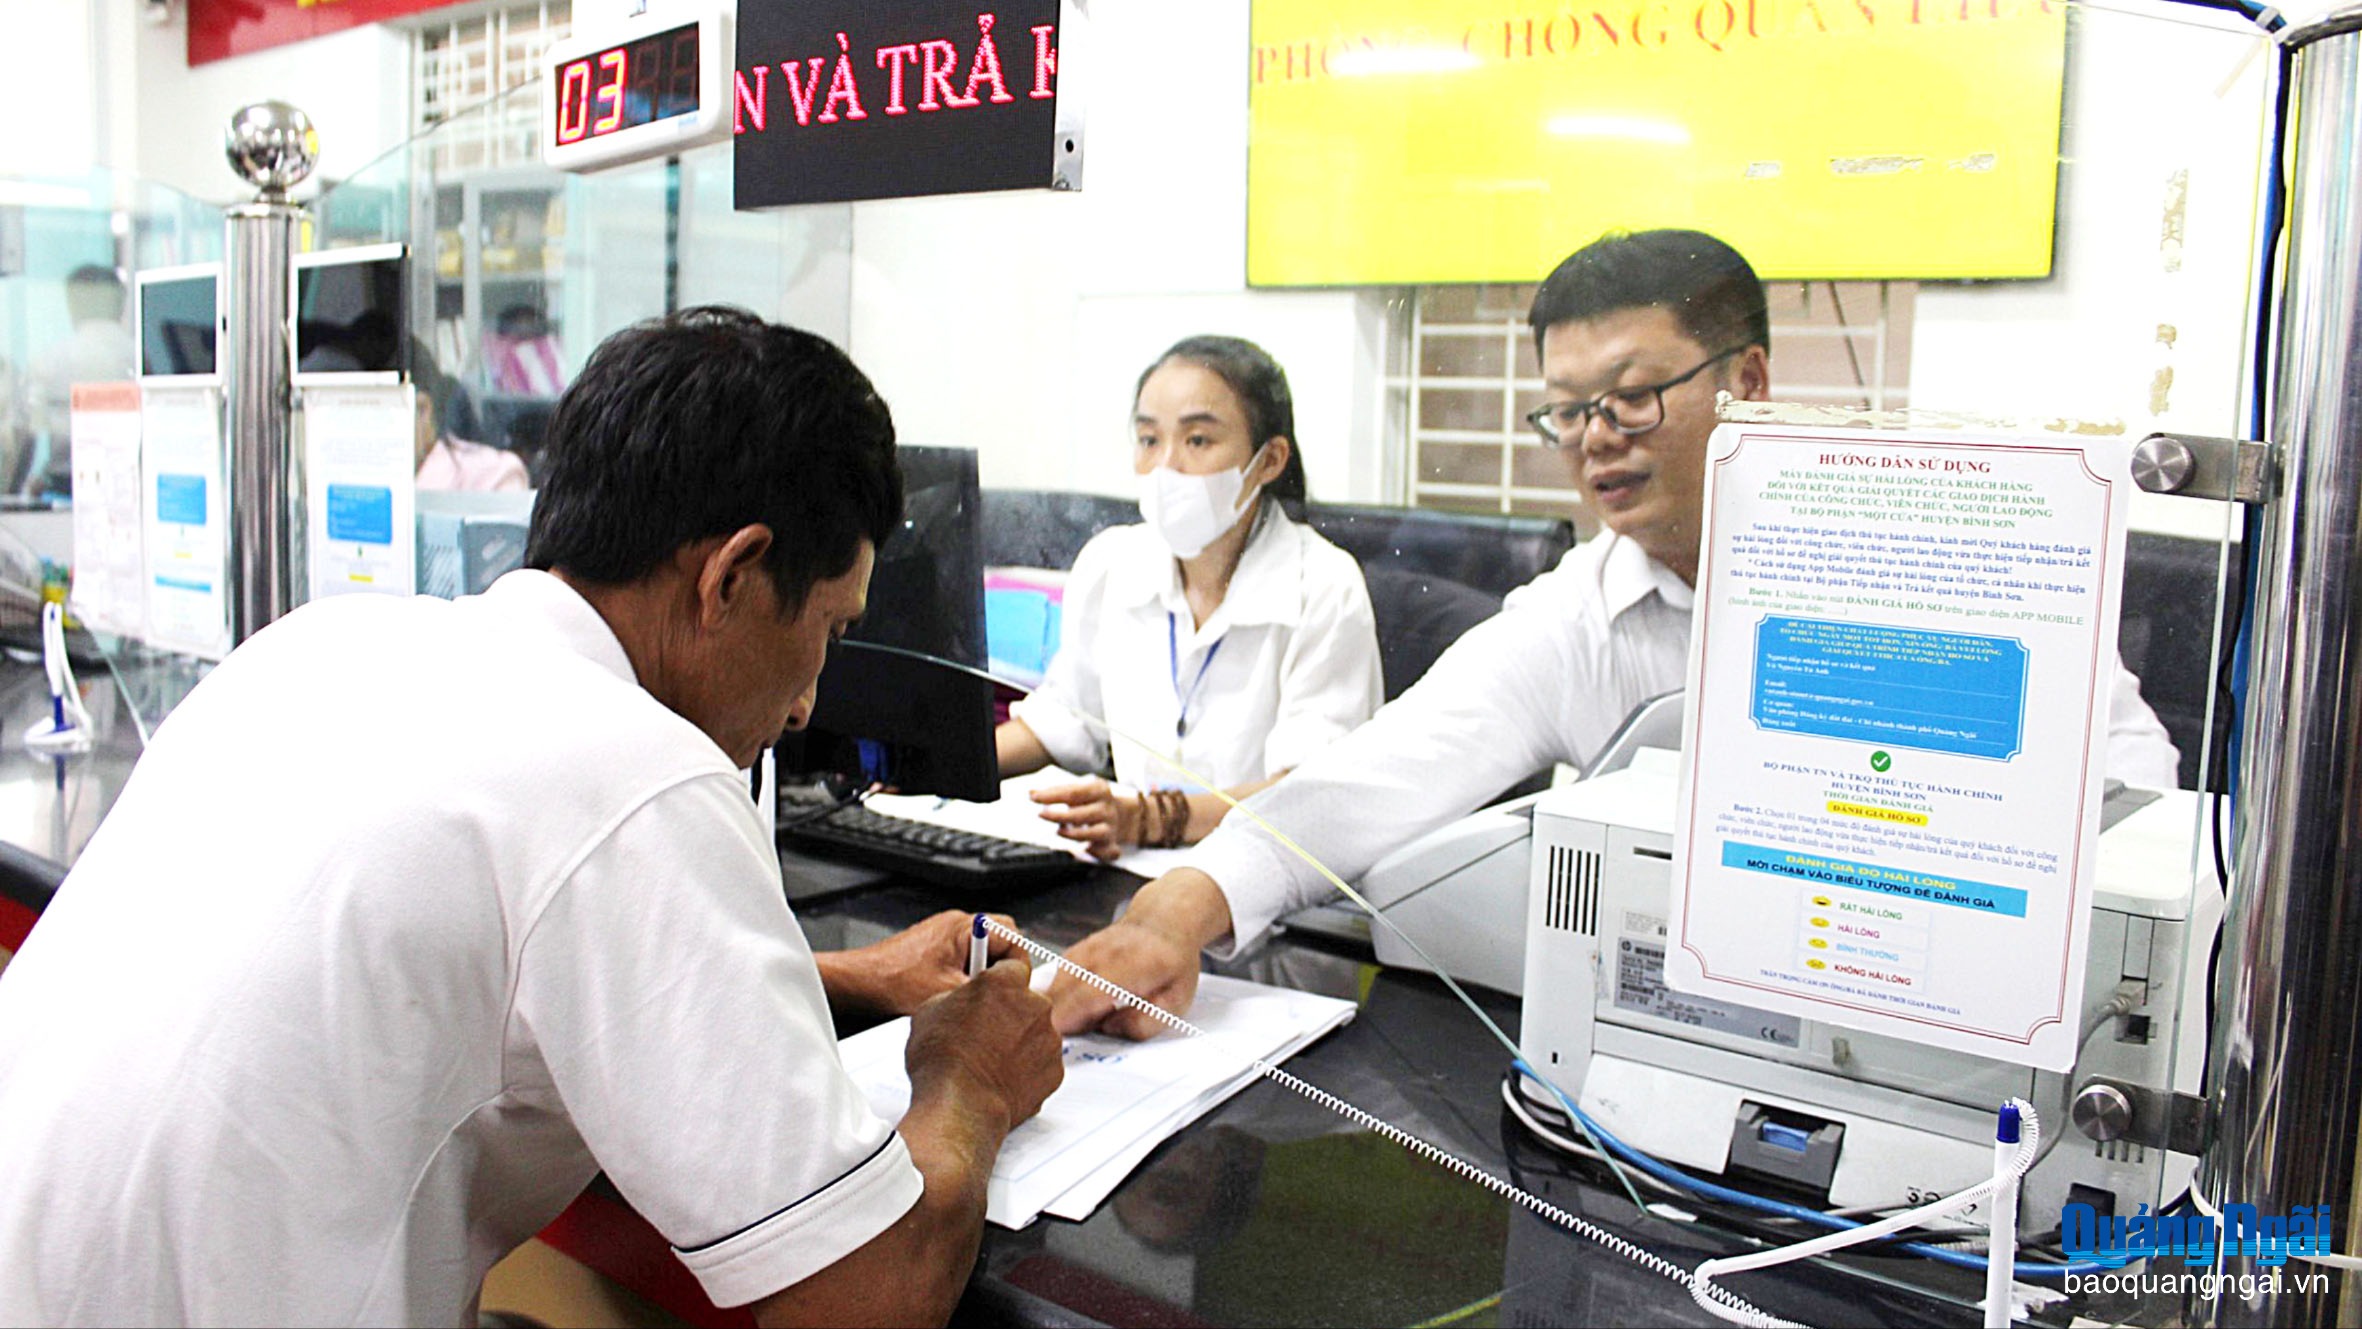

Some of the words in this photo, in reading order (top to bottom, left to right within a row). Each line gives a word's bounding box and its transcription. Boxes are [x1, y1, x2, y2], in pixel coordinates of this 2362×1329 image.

[781, 31, 868, 126] VÀ
[876, 13, 1016, 115] TRẢ
[558, 48, 628, 143] 03
[1819, 452, 1876, 468] HƯỚNG
[1880, 453, 1913, 469] DẪN
[1918, 456, 1940, 471] SỬ
[1943, 459, 1990, 475] DỤNG
[1746, 858, 1768, 870] MỜI
[1771, 862, 1805, 876] CHẠM
[1807, 868, 1832, 881] VÀO
[1835, 873, 1863, 887] BIỂU
[1866, 878, 1911, 895] TƯỢNG
[1913, 886, 1930, 898] ĐỂ
[1933, 890, 1969, 905] ĐÁNH
[1972, 897, 1995, 909] GIÁ
[1839, 901, 1857, 912] RẤT
[1859, 905, 1875, 916] HÀI
[1876, 907, 1902, 921] LÒNG
[1837, 923, 1852, 934] HÀI
[1854, 926, 1880, 939] LÒNG
[1833, 963, 1866, 977] KHÔNG
[1868, 970, 1883, 981] HÀI
[1885, 973, 1911, 986] LÒNG
